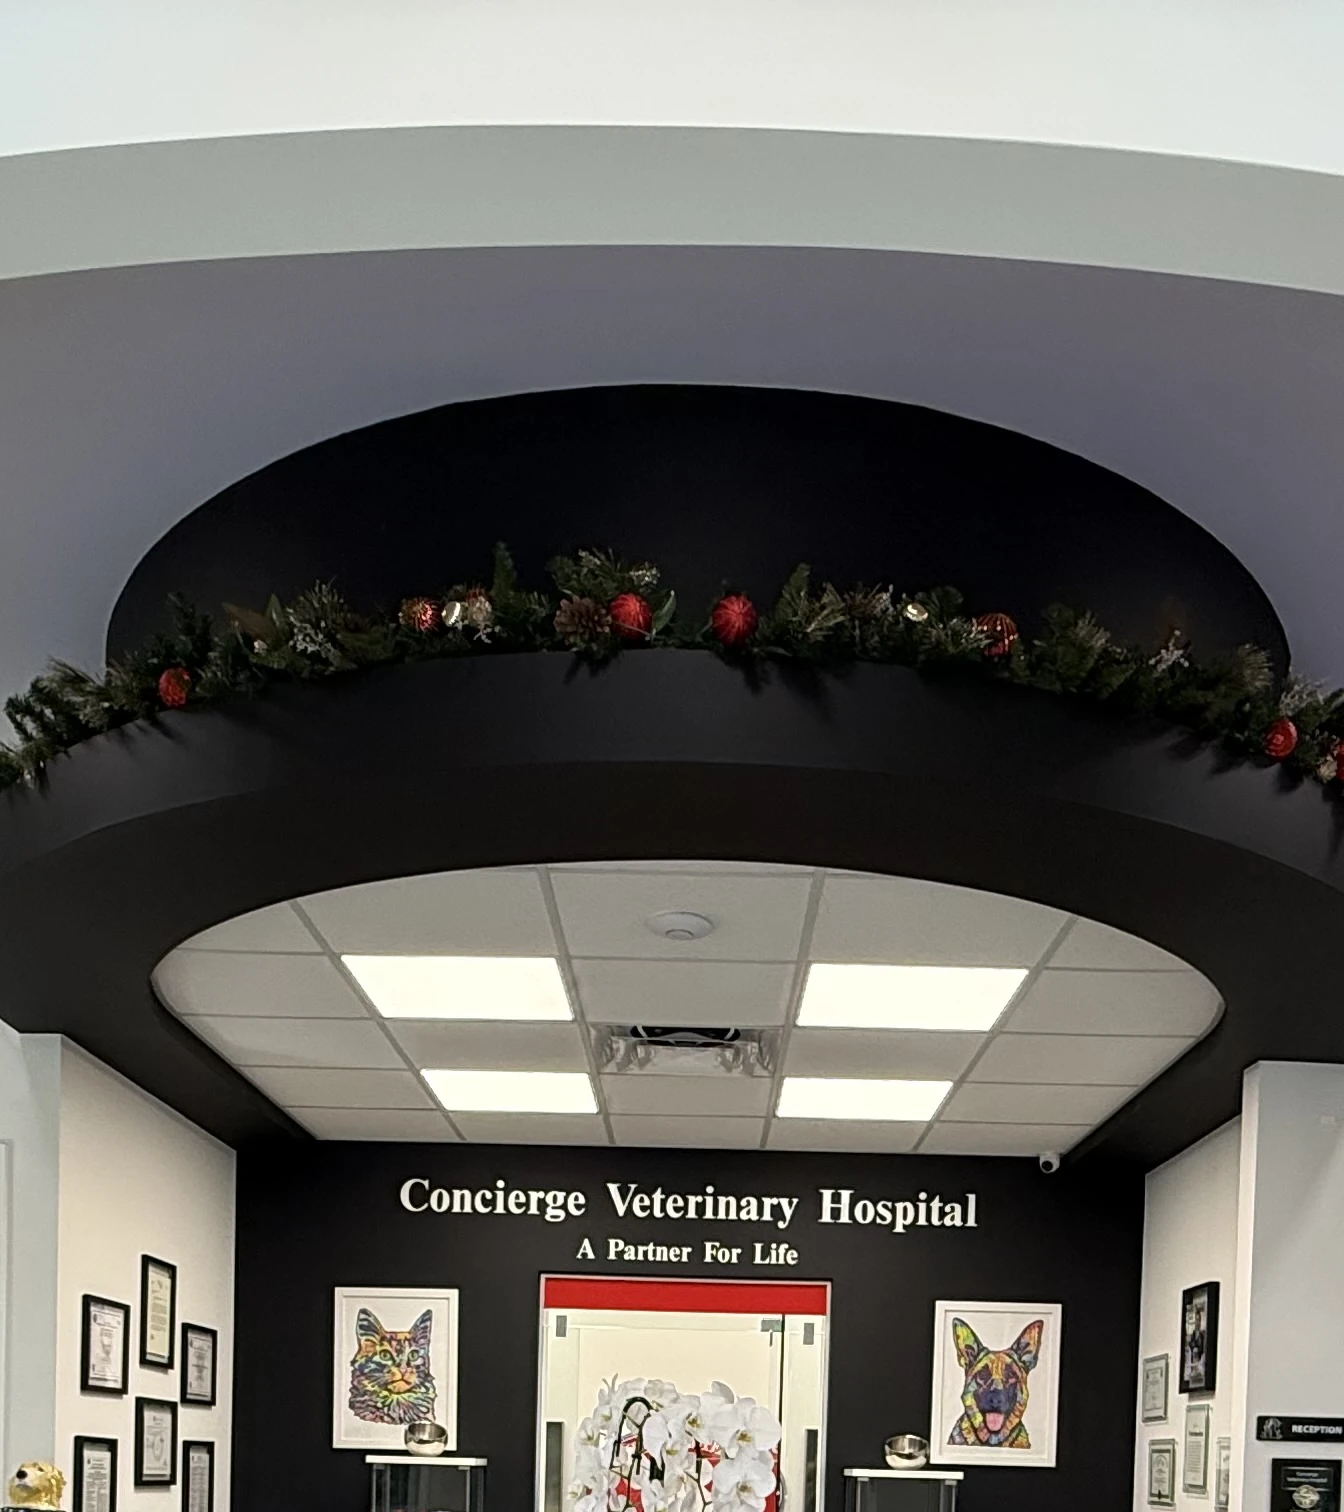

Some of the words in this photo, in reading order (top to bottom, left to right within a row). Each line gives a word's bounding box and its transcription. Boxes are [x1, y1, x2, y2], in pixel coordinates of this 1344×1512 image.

[399, 1178, 587, 1222] Concierge
[606, 1183, 799, 1229] Veterinary
[817, 1188, 979, 1233] Hospital
[576, 1239, 595, 1261] A
[607, 1239, 692, 1264] Partner
[704, 1241, 742, 1264] For
[753, 1242, 798, 1266] Life
[1291, 1425, 1343, 1434] RECEPTION
